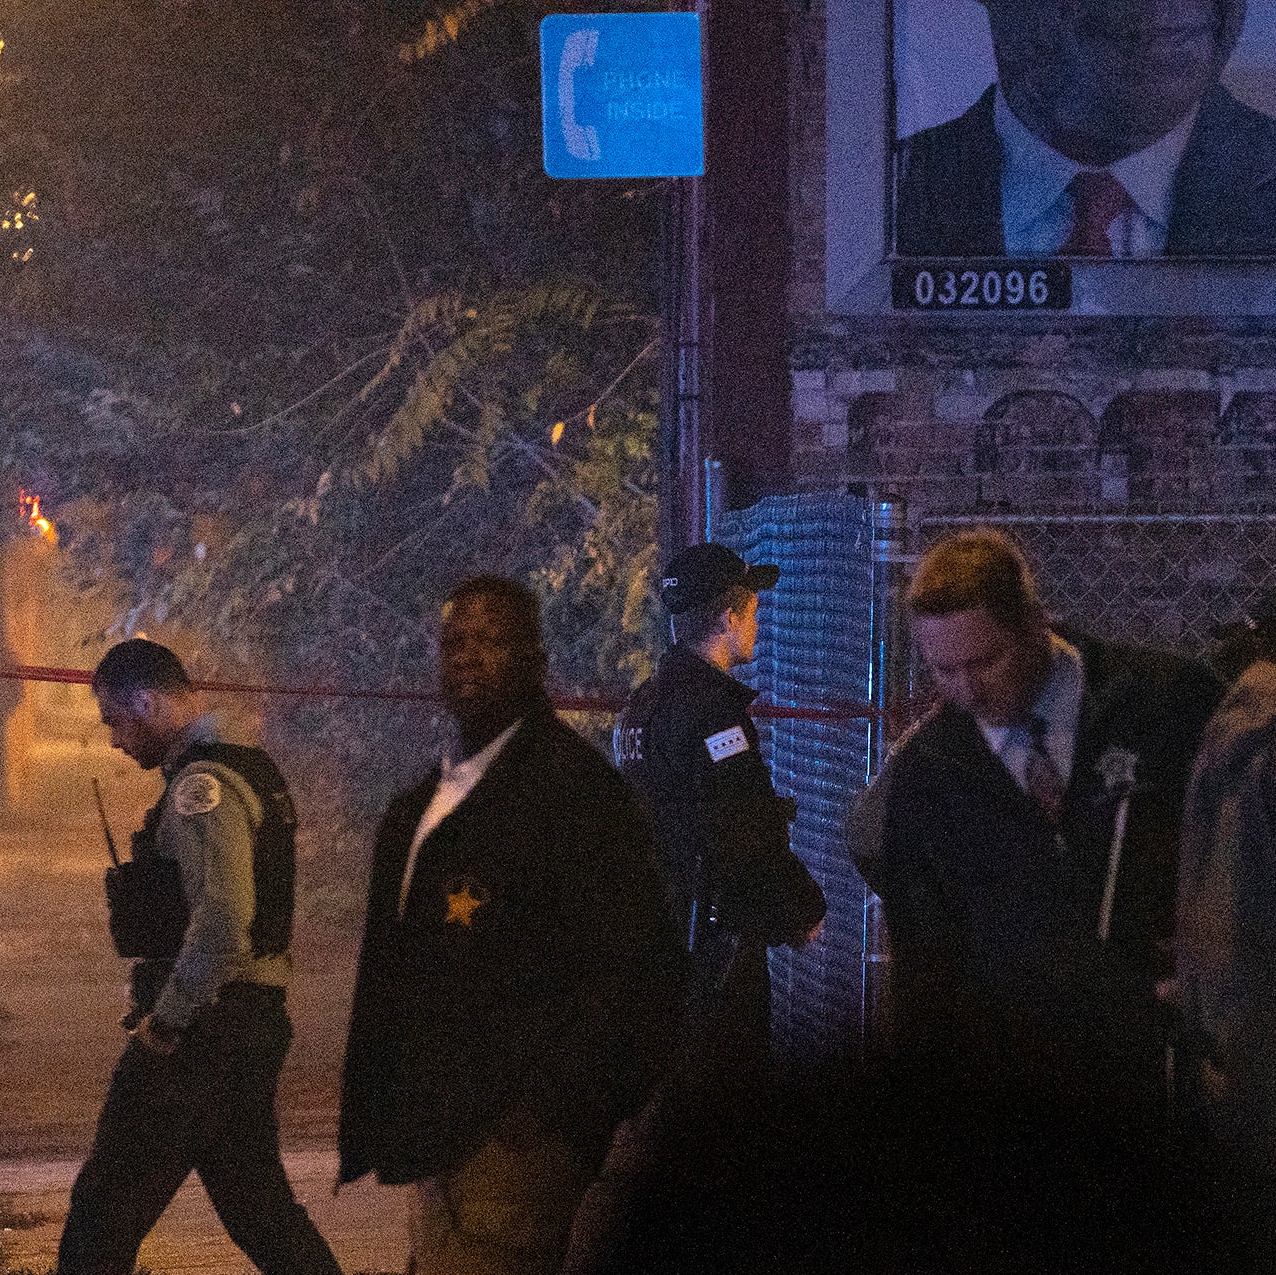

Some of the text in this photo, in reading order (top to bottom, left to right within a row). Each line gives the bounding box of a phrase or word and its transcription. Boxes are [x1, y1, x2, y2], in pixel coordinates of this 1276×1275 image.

[604, 70, 685, 90] PHONE
[607, 101, 687, 120] INSIDE
[915, 270, 1049, 304] 032096
